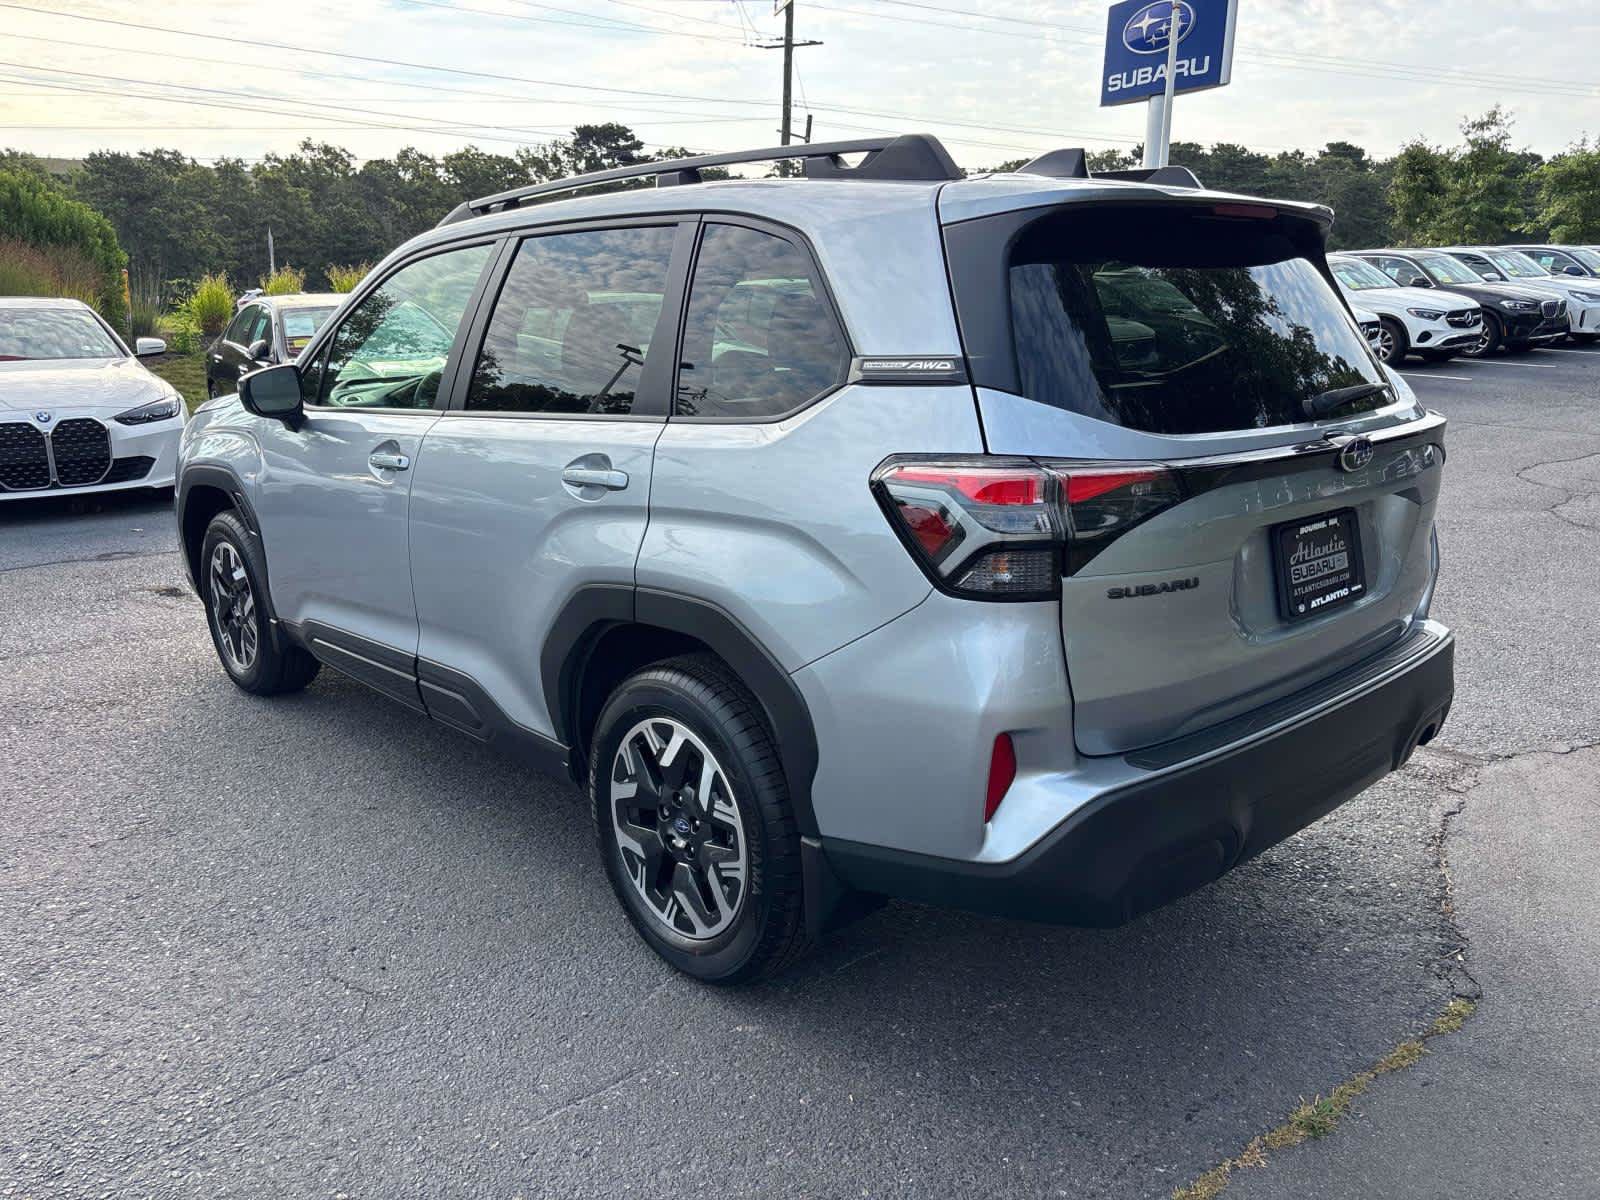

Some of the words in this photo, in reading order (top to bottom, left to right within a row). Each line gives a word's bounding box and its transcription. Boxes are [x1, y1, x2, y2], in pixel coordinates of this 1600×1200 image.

[1108, 56, 1210, 92] SUBARU
[1290, 534, 1347, 565] Atlantic
[1293, 559, 1336, 581] SUBARU
[1107, 577, 1200, 599] SUBARU
[1311, 588, 1350, 608] ATLANTIC
